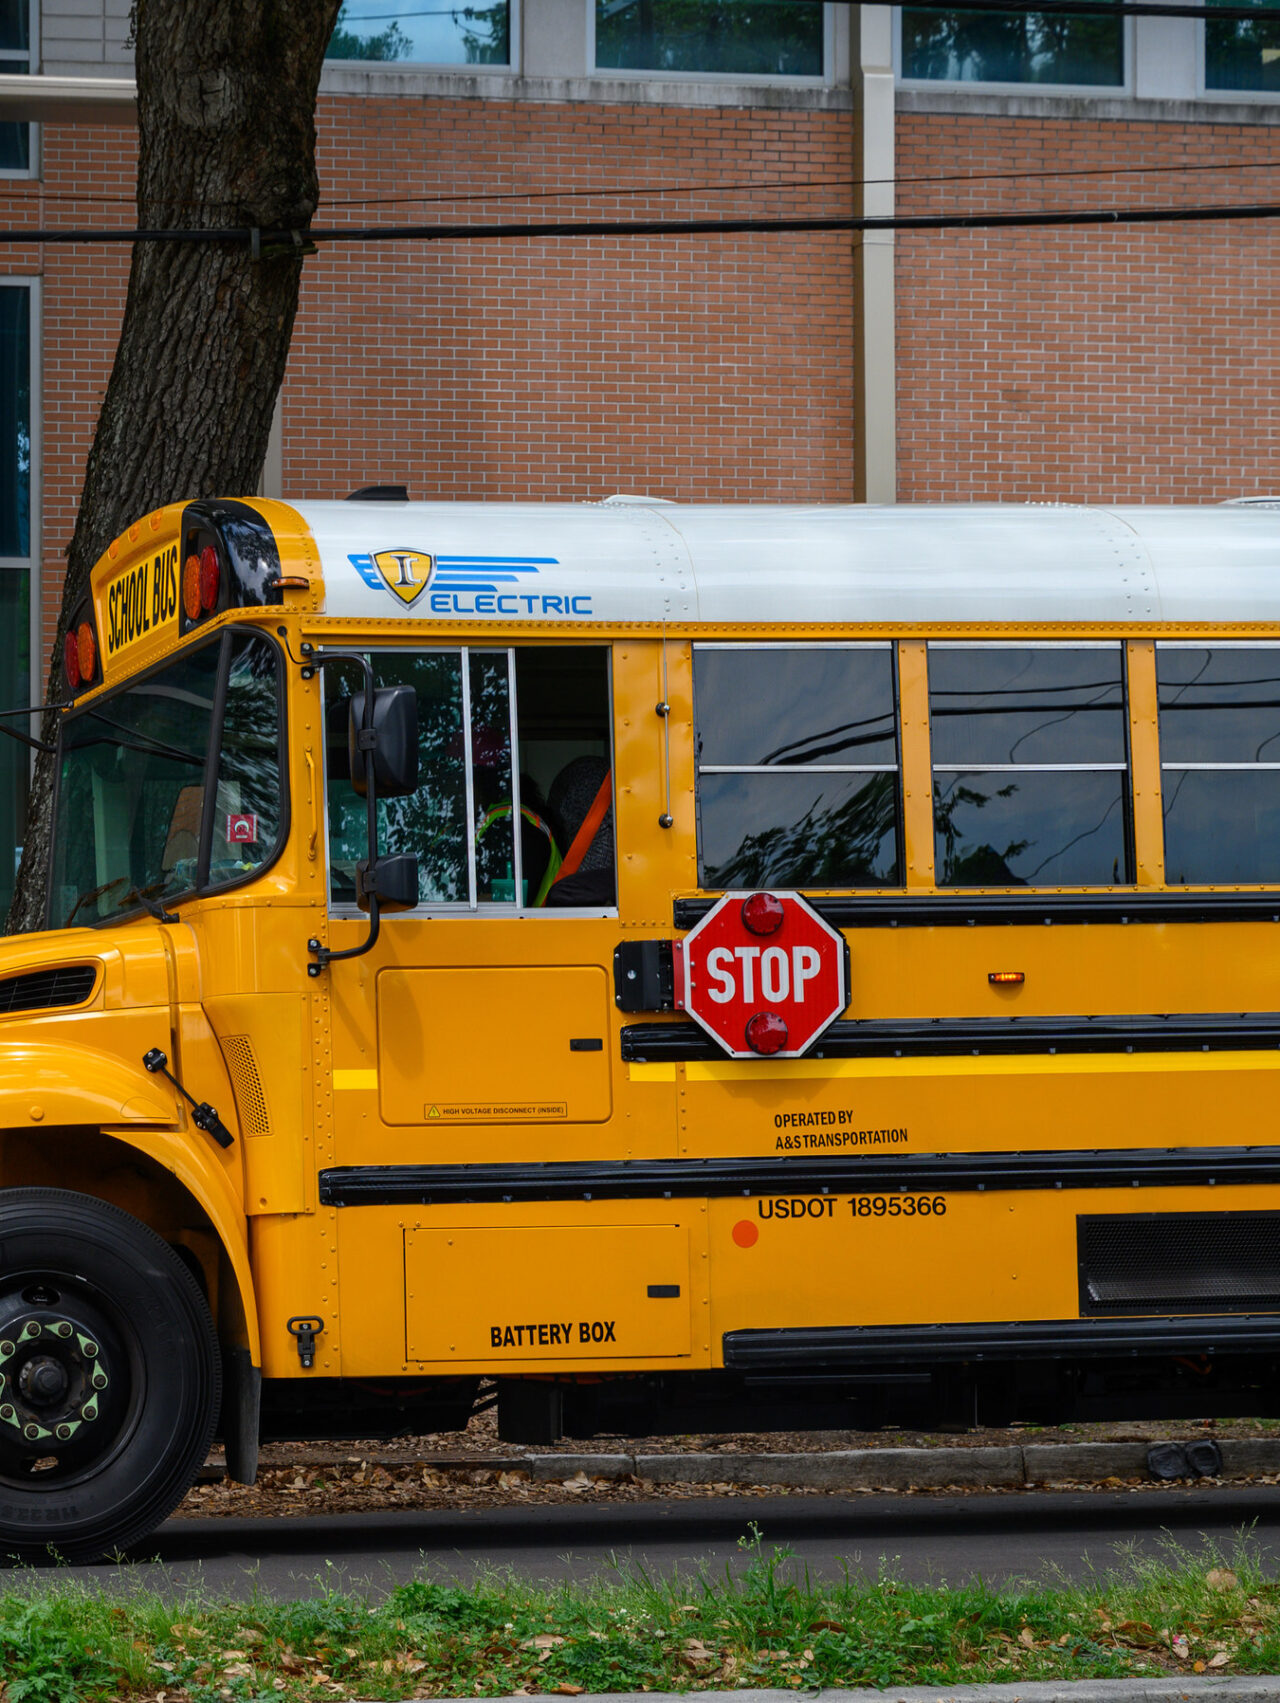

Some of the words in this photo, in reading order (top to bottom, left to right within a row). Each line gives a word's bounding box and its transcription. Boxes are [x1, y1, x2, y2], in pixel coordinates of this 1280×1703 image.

[109, 563, 149, 654] SCHOOL
[153, 545, 177, 627] BUS
[430, 593, 593, 615] ELECTRIC
[706, 946, 821, 1004] STOP
[461, 1107, 492, 1115] VOLTAGE
[493, 1106, 536, 1115] DISCONNECT
[537, 1105, 564, 1114] (INSIDE)
[774, 1111, 836, 1128] OPERATED
[838, 1110, 853, 1125] BY
[775, 1135, 801, 1150] A&S
[802, 1128, 909, 1149] TRANSPORTATION
[758, 1198, 837, 1219] USDOT
[847, 1196, 947, 1217] 1895366
[490, 1323, 573, 1347] BATTERY
[579, 1321, 616, 1343] BOX
